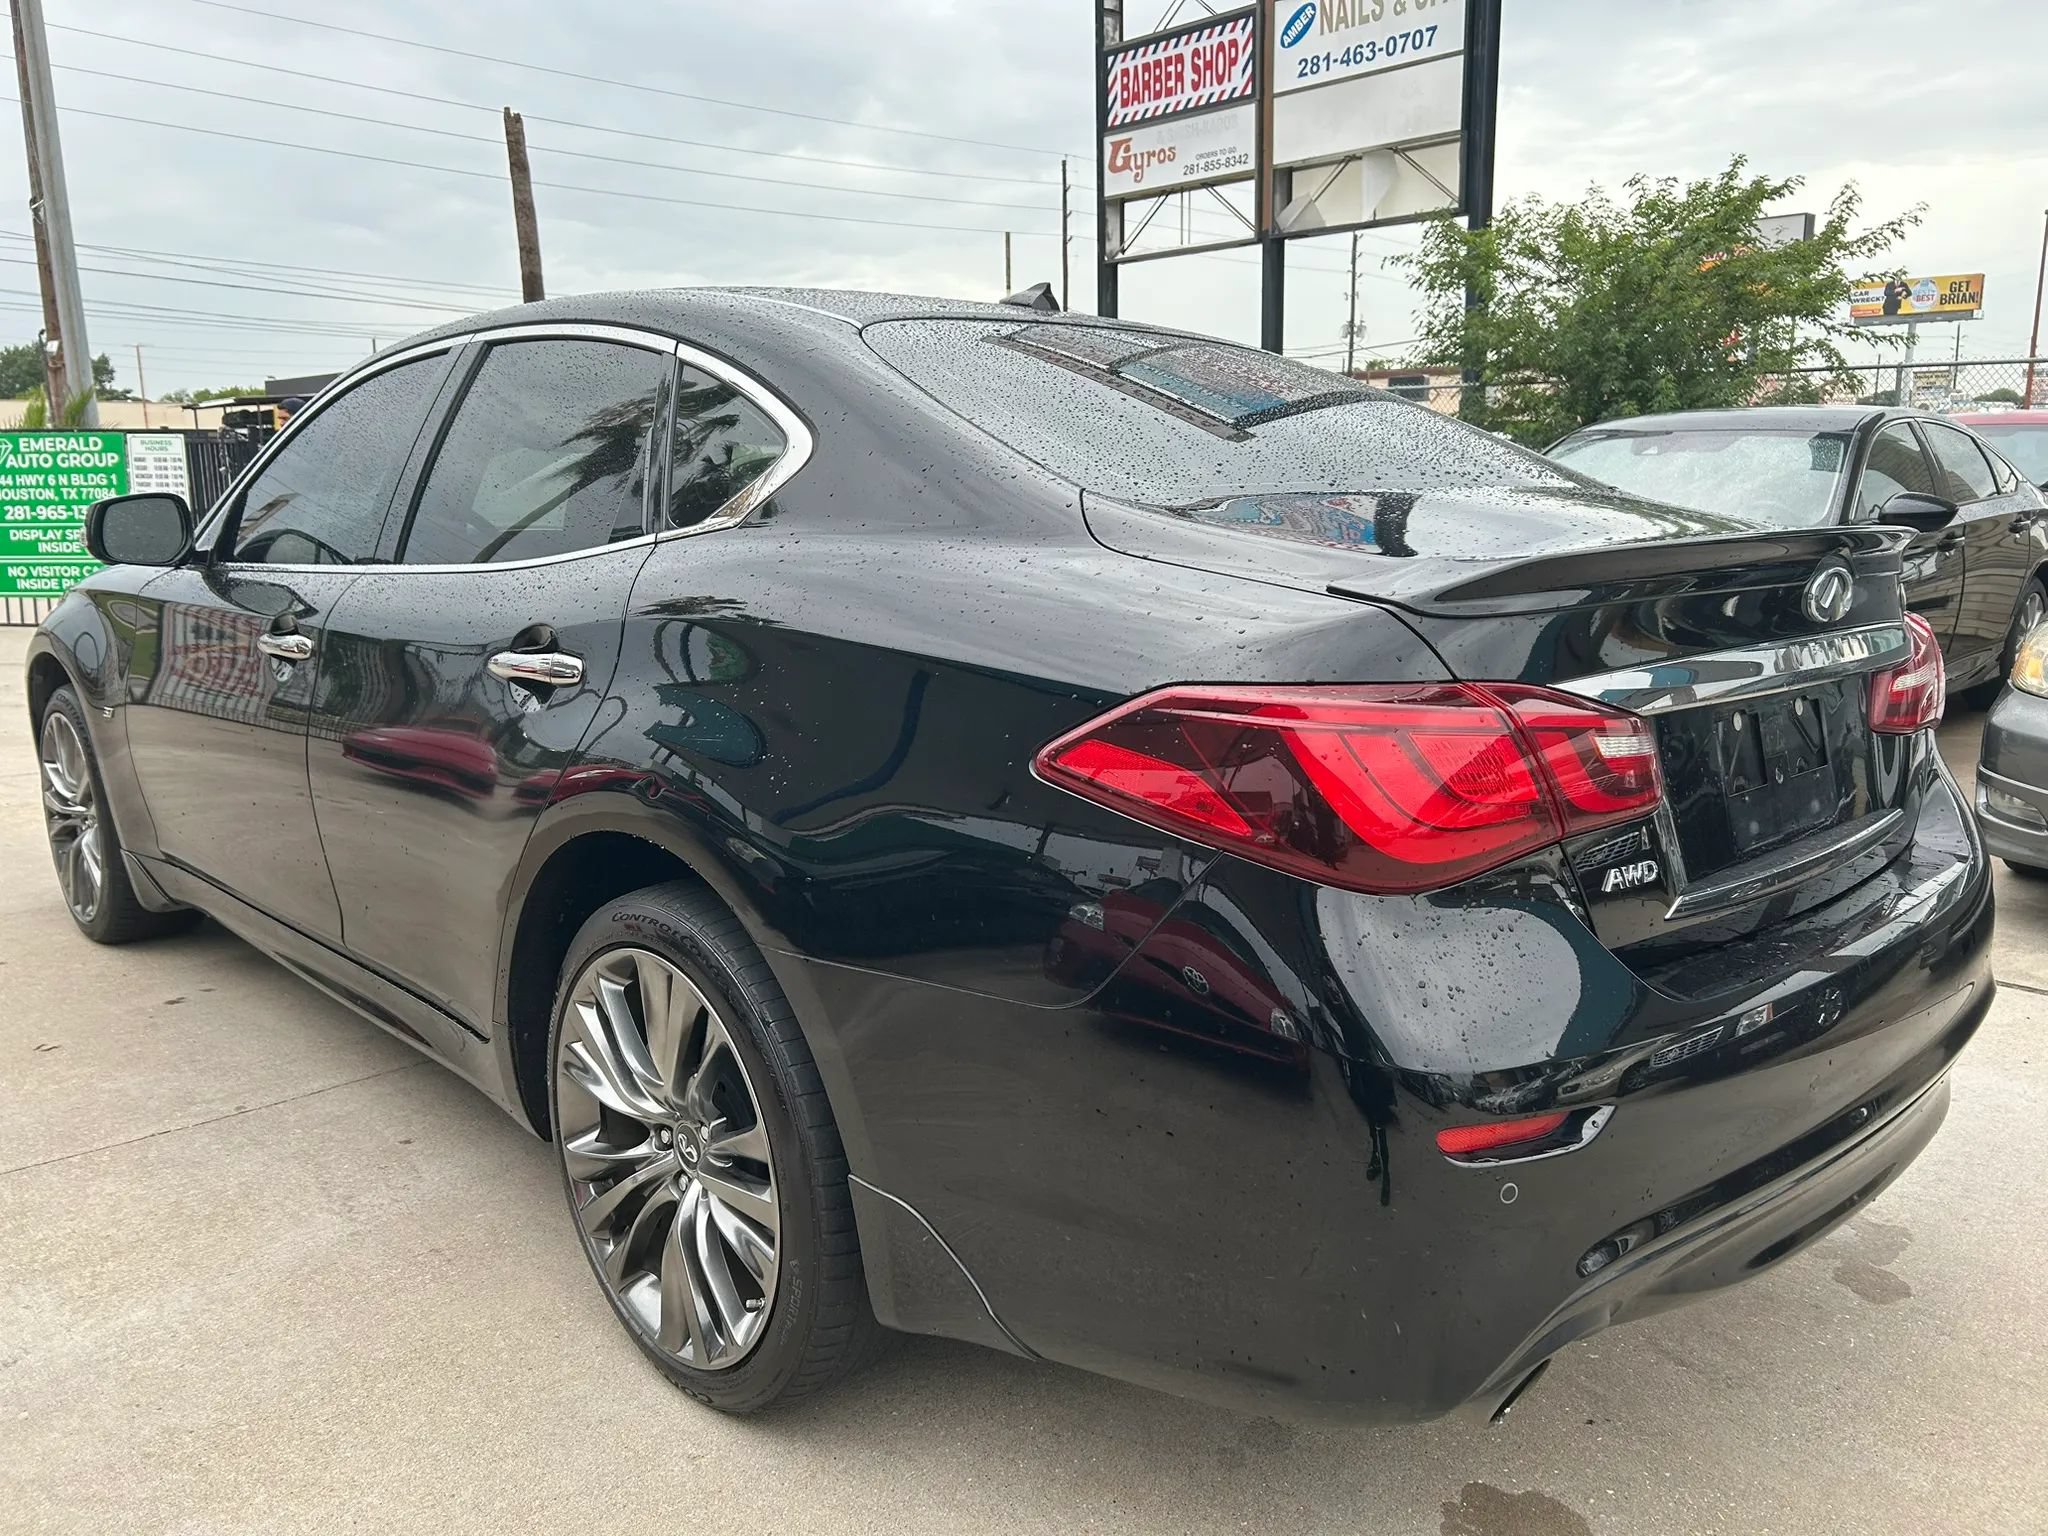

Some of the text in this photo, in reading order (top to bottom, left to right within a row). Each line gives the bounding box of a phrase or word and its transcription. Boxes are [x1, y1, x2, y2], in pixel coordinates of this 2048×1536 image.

[1282, 6, 1316, 47] AMBER
[1296, 25, 1438, 79] 281-463-0707
[1119, 38, 1239, 108] BARBER SHOP
[1108, 137, 1177, 184] Gyros
[1183, 153, 1249, 176] 281-855-8342
[1949, 280, 1971, 293] GET
[1939, 291, 1979, 306] BRIAN!
[19, 436, 103, 452] EMERALD
[5, 452, 119, 468] AUTO GROUP
[0, 473, 117, 486] 44 HWY 6 N BLDG 1
[0, 488, 59, 502] OUSTON,
[60, 487, 79, 500] TX
[3, 504, 87, 520] 281-965-13
[9, 529, 63, 540] DISPLAY
[38, 542, 82, 553] INSIDE
[7, 566, 28, 577] NO
[29, 566, 80, 577] VISITOR
[16, 579, 60, 590] INSIDE
[1601, 860, 1659, 893] AWD
